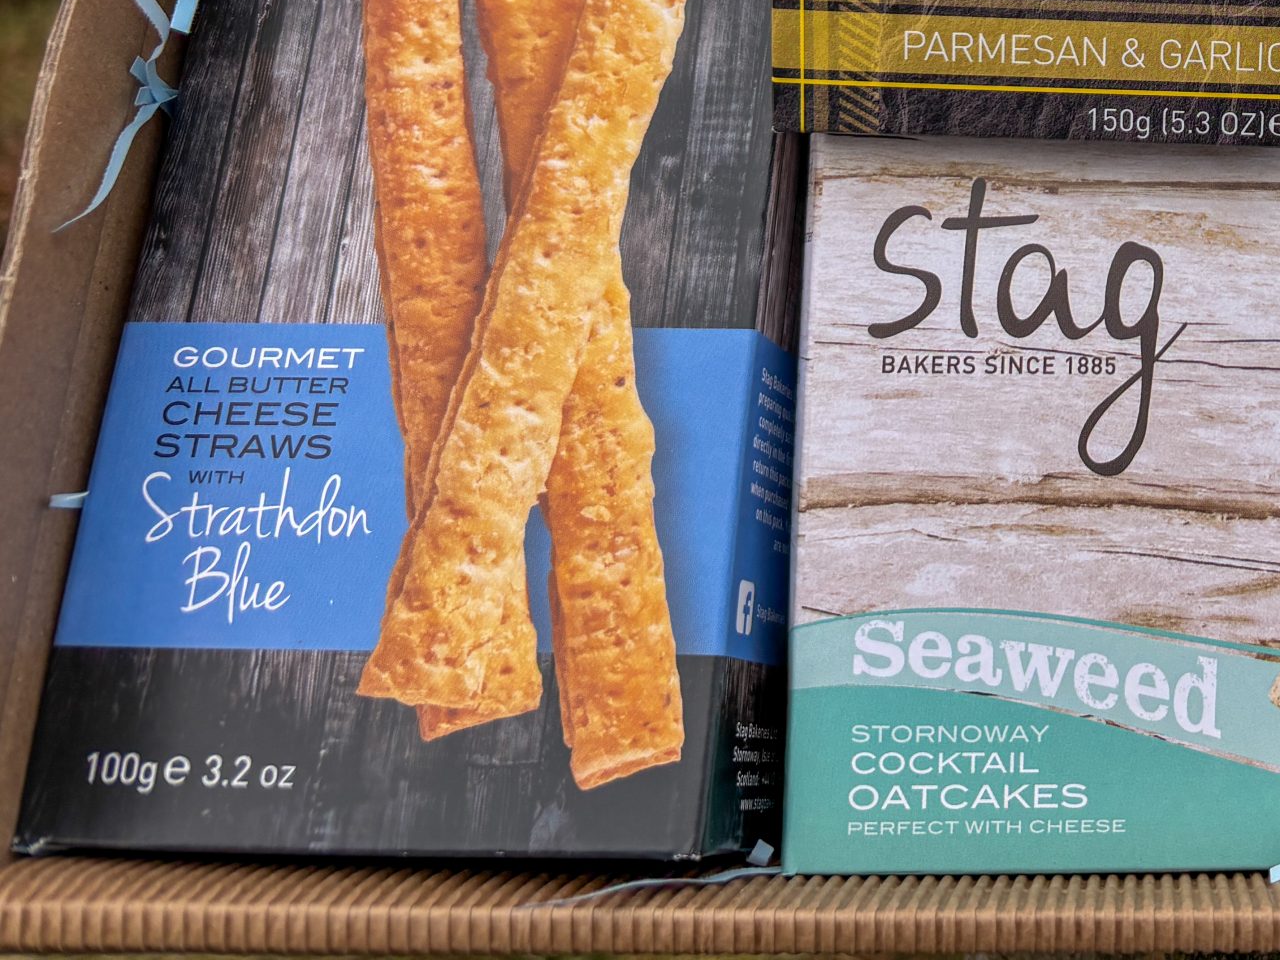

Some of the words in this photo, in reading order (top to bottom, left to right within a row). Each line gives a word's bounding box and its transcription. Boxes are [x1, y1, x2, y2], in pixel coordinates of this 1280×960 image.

[902, 30, 1109, 68] PARMESAN
[1122, 38, 1148, 69] &
[1088, 107, 1151, 139] 150g
[1162, 107, 1211, 136] (5.3
[172, 345, 365, 371] GOURMET
[880, 353, 977, 375] BAKERS
[983, 353, 1056, 376] SINCE
[1062, 353, 1118, 376] 1885
[165, 376, 221, 395] ALL
[227, 376, 350, 396] BUTTER
[160, 400, 339, 428] CHEESE
[152, 432, 333, 460] STRAWS
[187, 469, 246, 486] WITH
[143, 468, 374, 547] Strathdon
[179, 544, 292, 625] Blue
[852, 619, 1222, 740] Seaweed
[850, 723, 1050, 745] STORNOWAY
[201, 754, 252, 787] 3.2
[259, 764, 297, 788] oz
[850, 751, 1041, 777] COCKTAIL
[847, 783, 1089, 811] OATCAKES
[847, 819, 959, 835] PERFECT
[965, 818, 1024, 835] WITH
[1030, 818, 1127, 835] CHEESE
